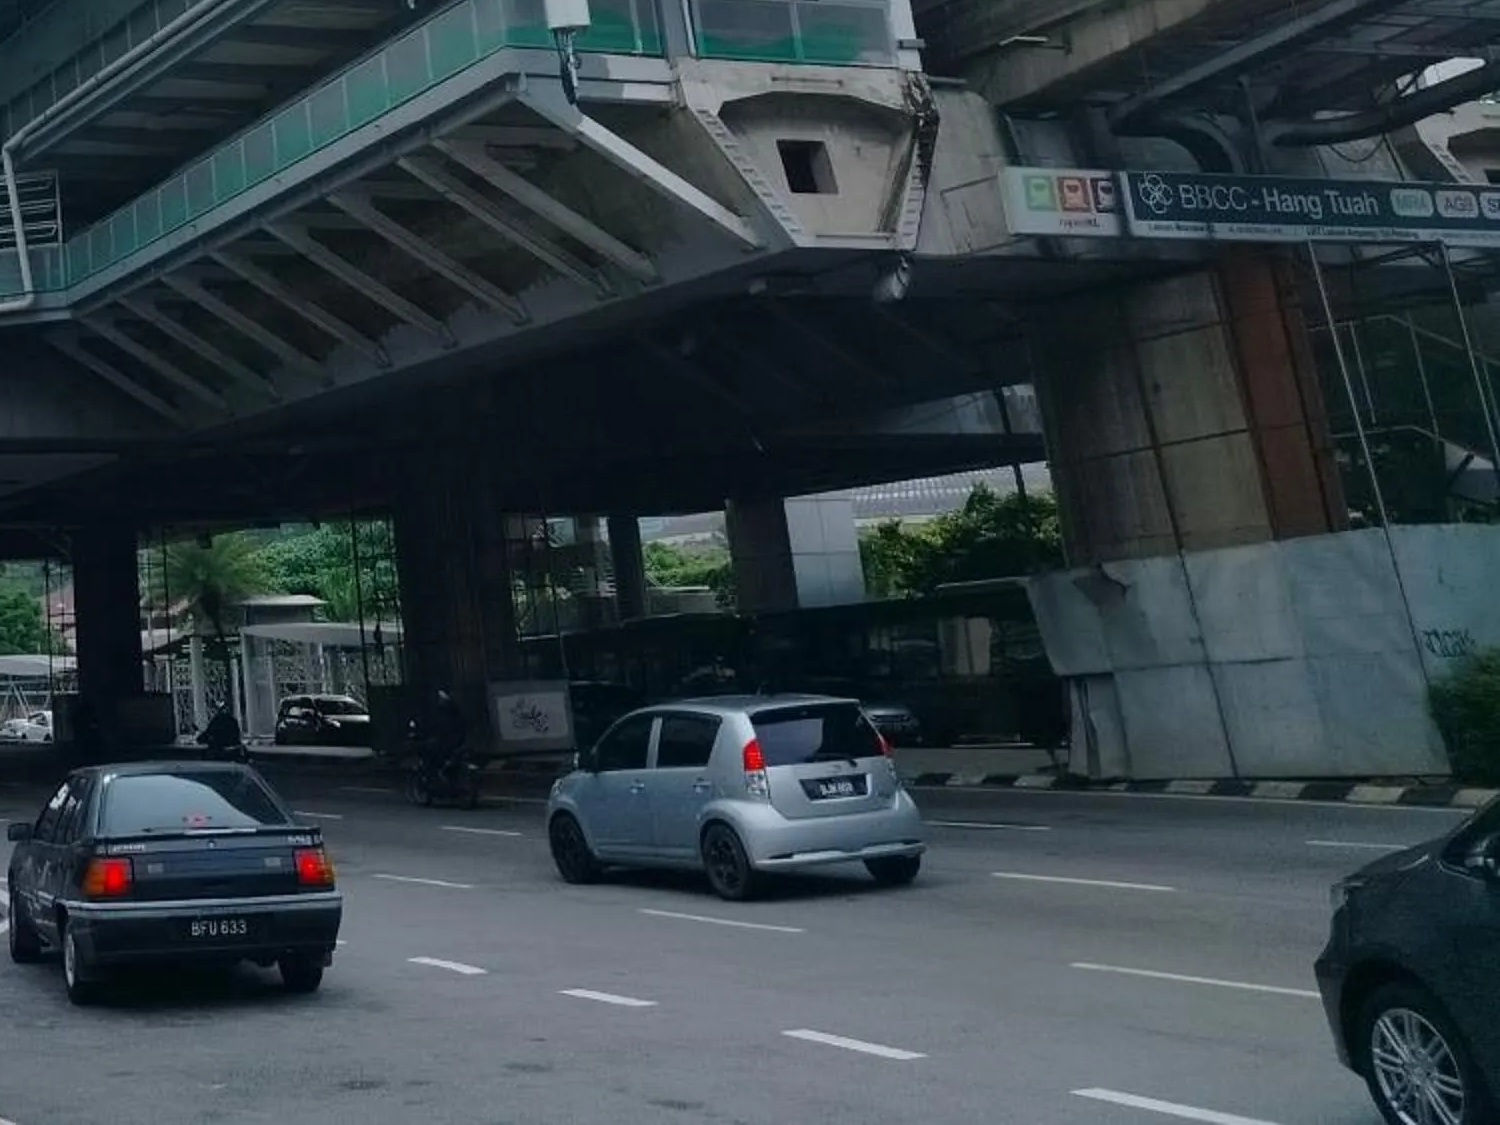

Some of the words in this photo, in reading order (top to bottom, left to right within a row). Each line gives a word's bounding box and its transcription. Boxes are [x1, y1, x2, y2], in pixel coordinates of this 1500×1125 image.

[1178, 183, 1248, 211] BBCC
[1261, 186, 1324, 220] Hang
[1323, 189, 1380, 216] Tuah
[191, 921, 217, 936] BFU
[220, 920, 248, 935] 633
